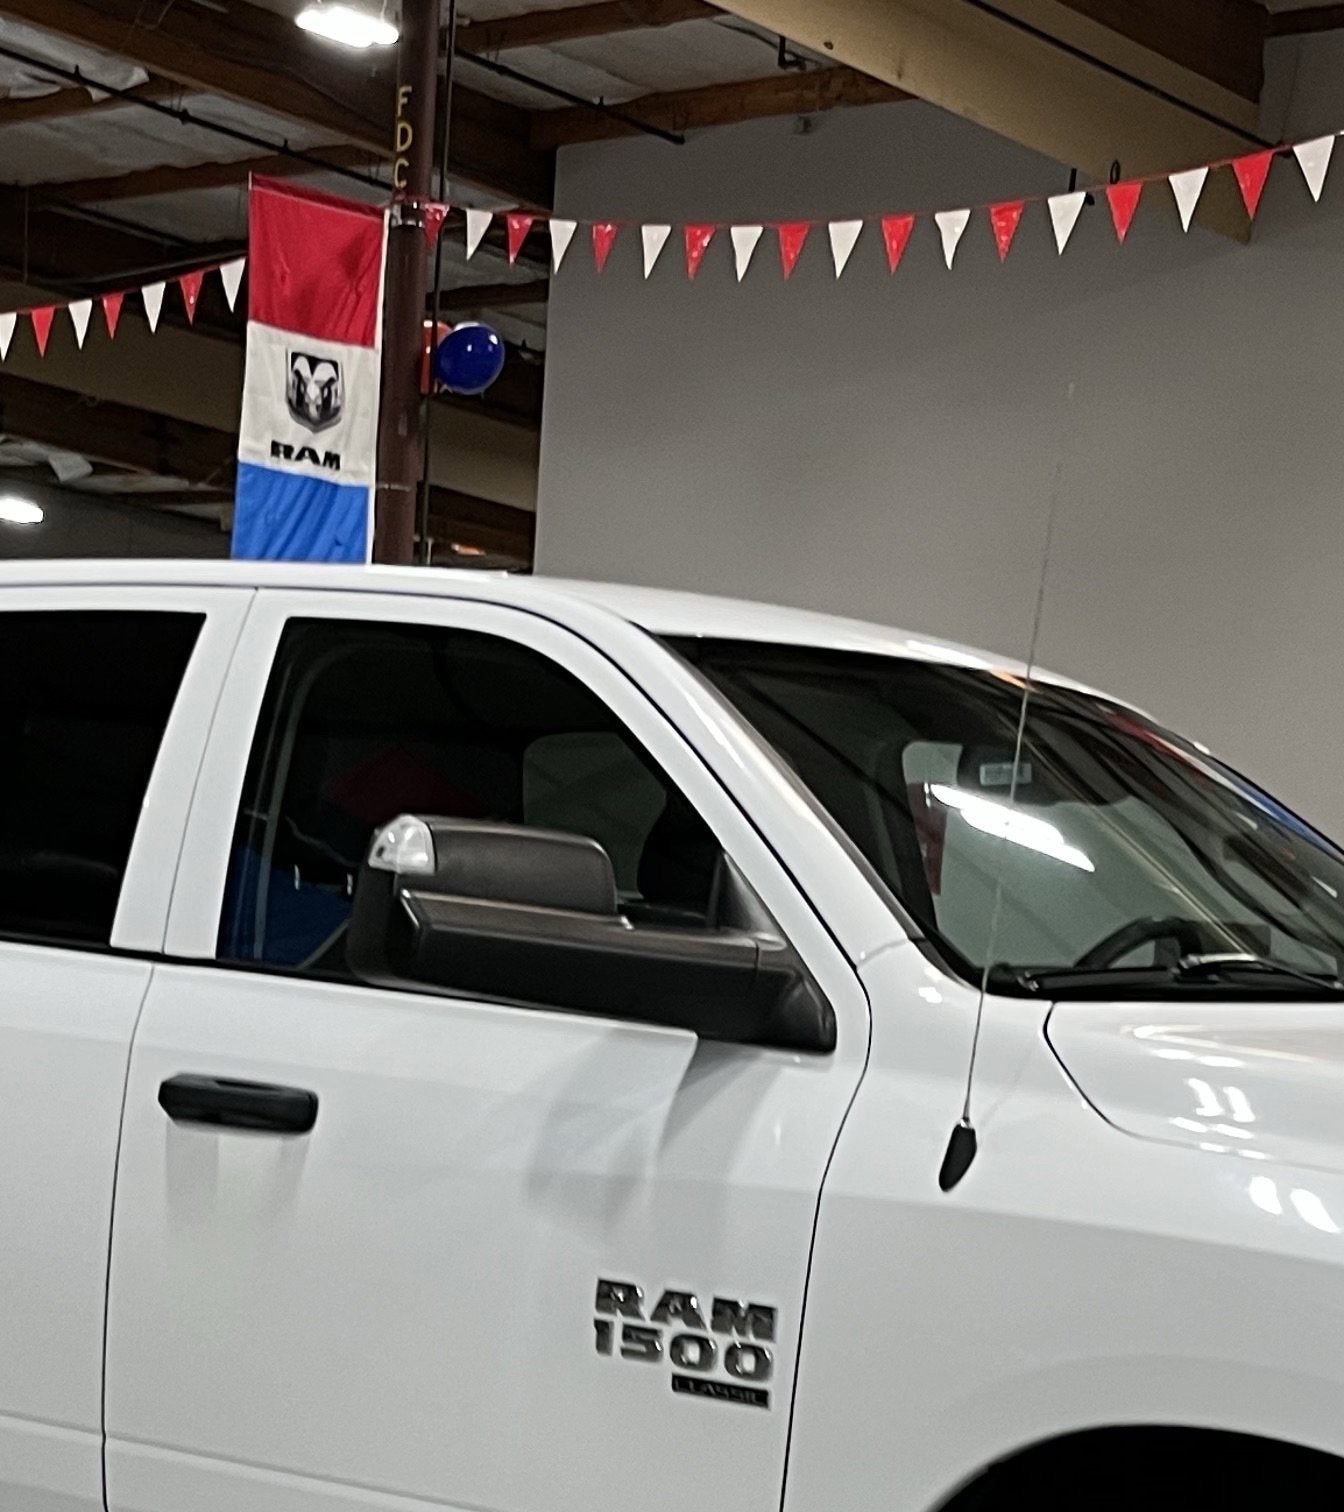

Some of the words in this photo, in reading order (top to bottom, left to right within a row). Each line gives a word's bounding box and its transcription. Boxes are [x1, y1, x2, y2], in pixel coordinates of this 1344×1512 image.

[394, 84, 413, 189] FDC
[270, 439, 341, 471] RAM
[595, 1277, 778, 1344] RAM
[593, 1317, 774, 1383] 1500
